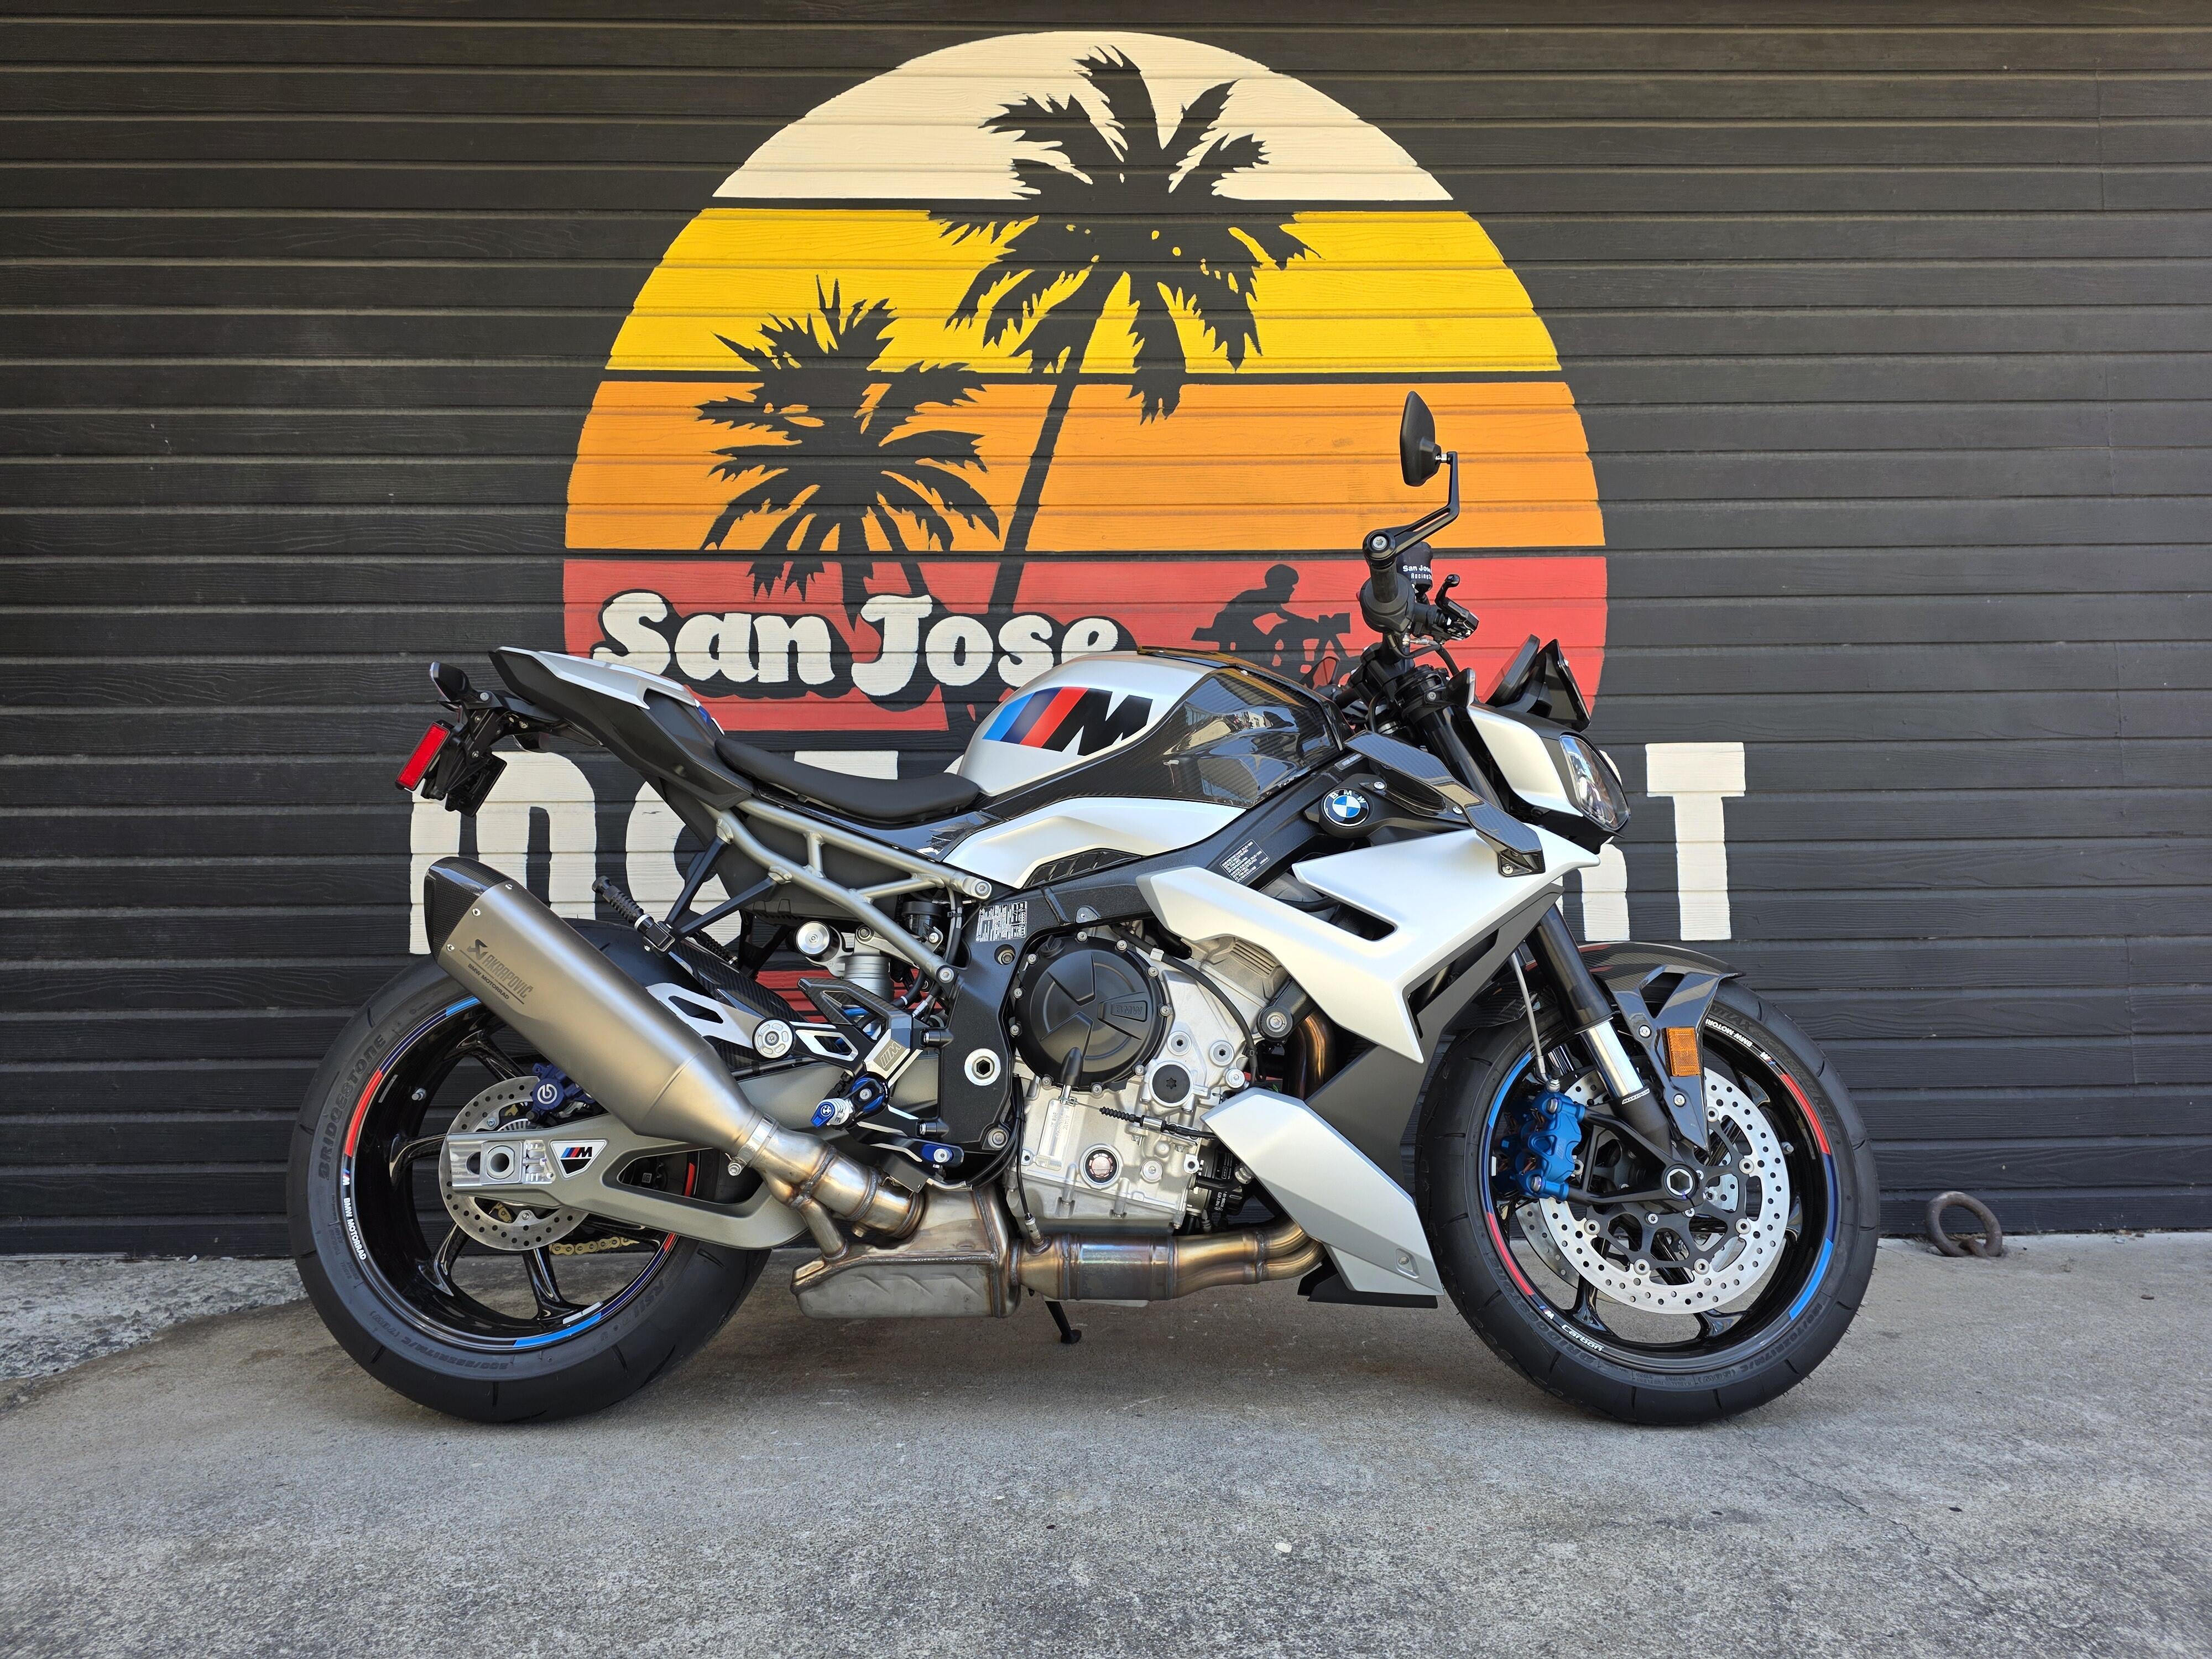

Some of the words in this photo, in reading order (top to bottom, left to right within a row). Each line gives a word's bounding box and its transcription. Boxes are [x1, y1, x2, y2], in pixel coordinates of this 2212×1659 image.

[592, 591, 836, 686] San
[851, 593, 1119, 697] Jose
[1041, 687, 1153, 757] M
[1329, 790, 1366, 804] BMW
[468, 963, 482, 976] BMW
[481, 975, 509, 1000] MOTORRAD
[1116, 1005, 1143, 1015] BMW
[1733, 1032, 1752, 1048] BMW
[318, 1033, 387, 1180] BRIDGESTONE
[343, 1197, 353, 1218] BMW
[347, 1218, 367, 1261] MOTORRAD
[1487, 1255, 1597, 1365] BRIDGESTONE
[1562, 1324, 1604, 1352] Carbon
